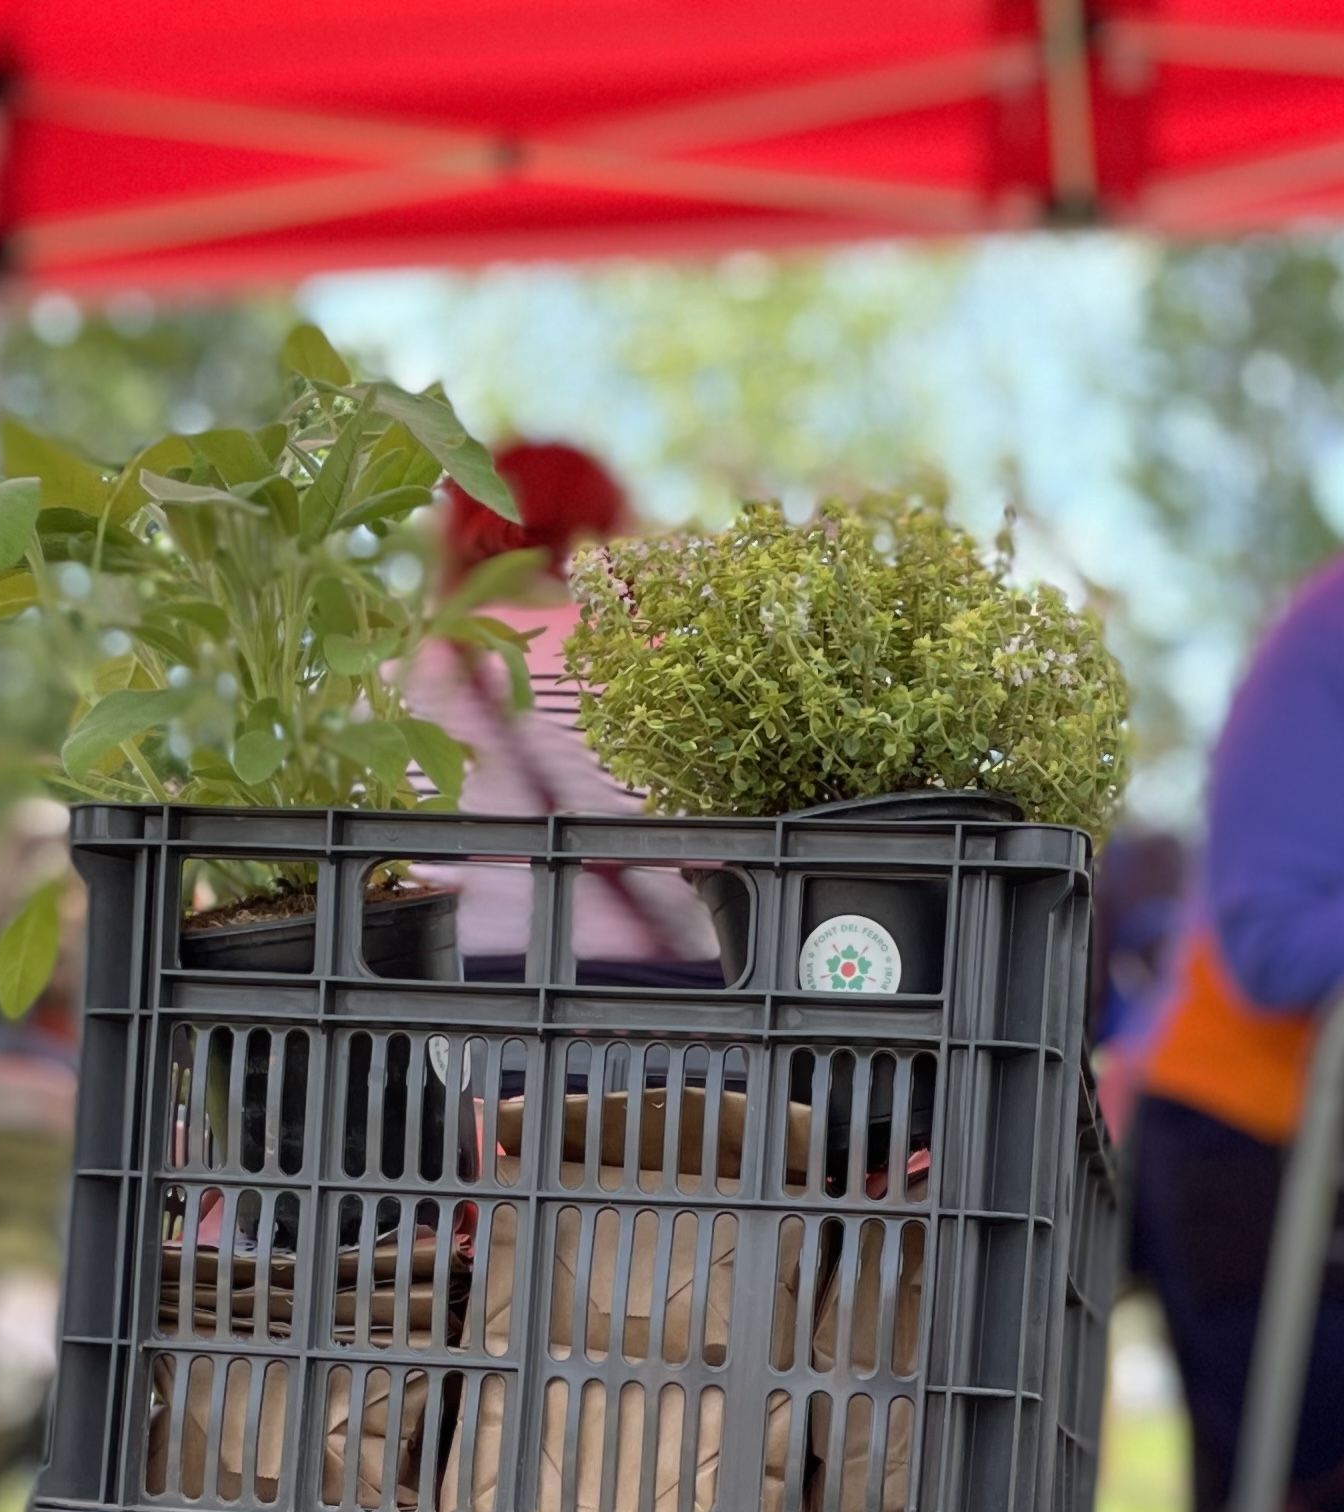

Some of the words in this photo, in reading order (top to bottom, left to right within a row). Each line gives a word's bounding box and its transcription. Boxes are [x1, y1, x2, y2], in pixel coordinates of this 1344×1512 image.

[814, 926, 838, 947] FONT
[841, 923, 859, 932] DEL
[862, 927, 889, 952] FERRO
